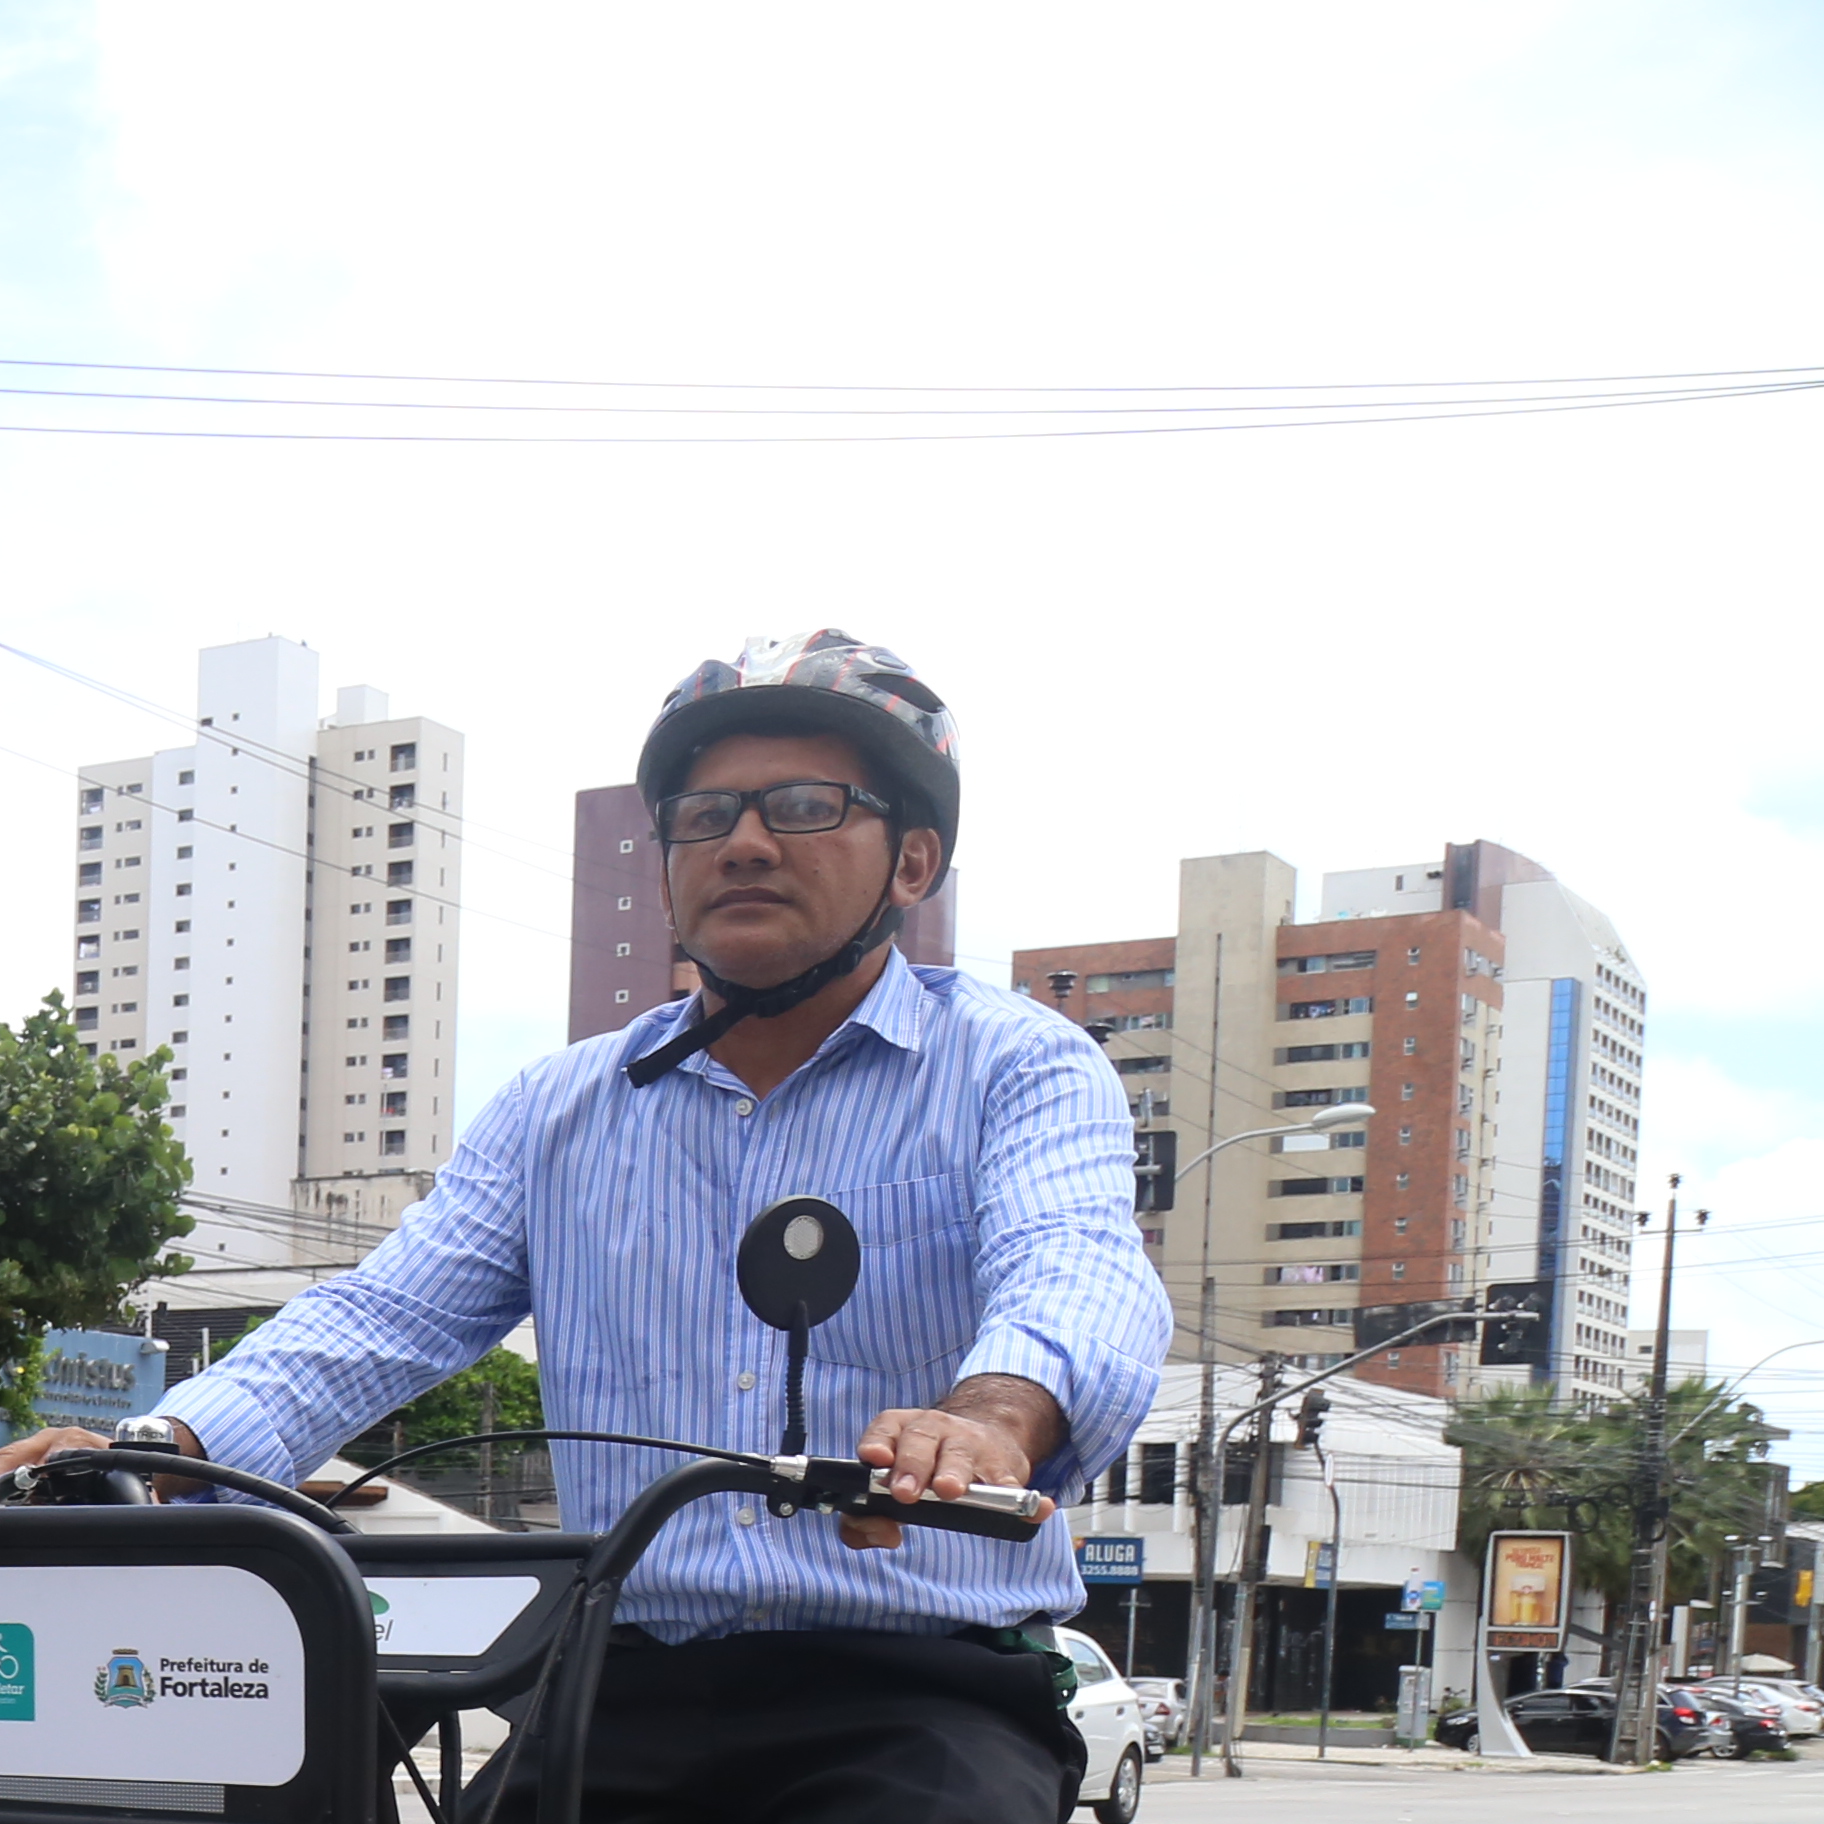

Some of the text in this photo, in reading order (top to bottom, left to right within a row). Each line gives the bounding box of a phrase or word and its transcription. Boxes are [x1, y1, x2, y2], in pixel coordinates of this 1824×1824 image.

[1085, 1543, 1136, 1562] ALUGA
[160, 1657, 270, 1673] Prefeitura de
[160, 1675, 269, 1699] Fortaleza
